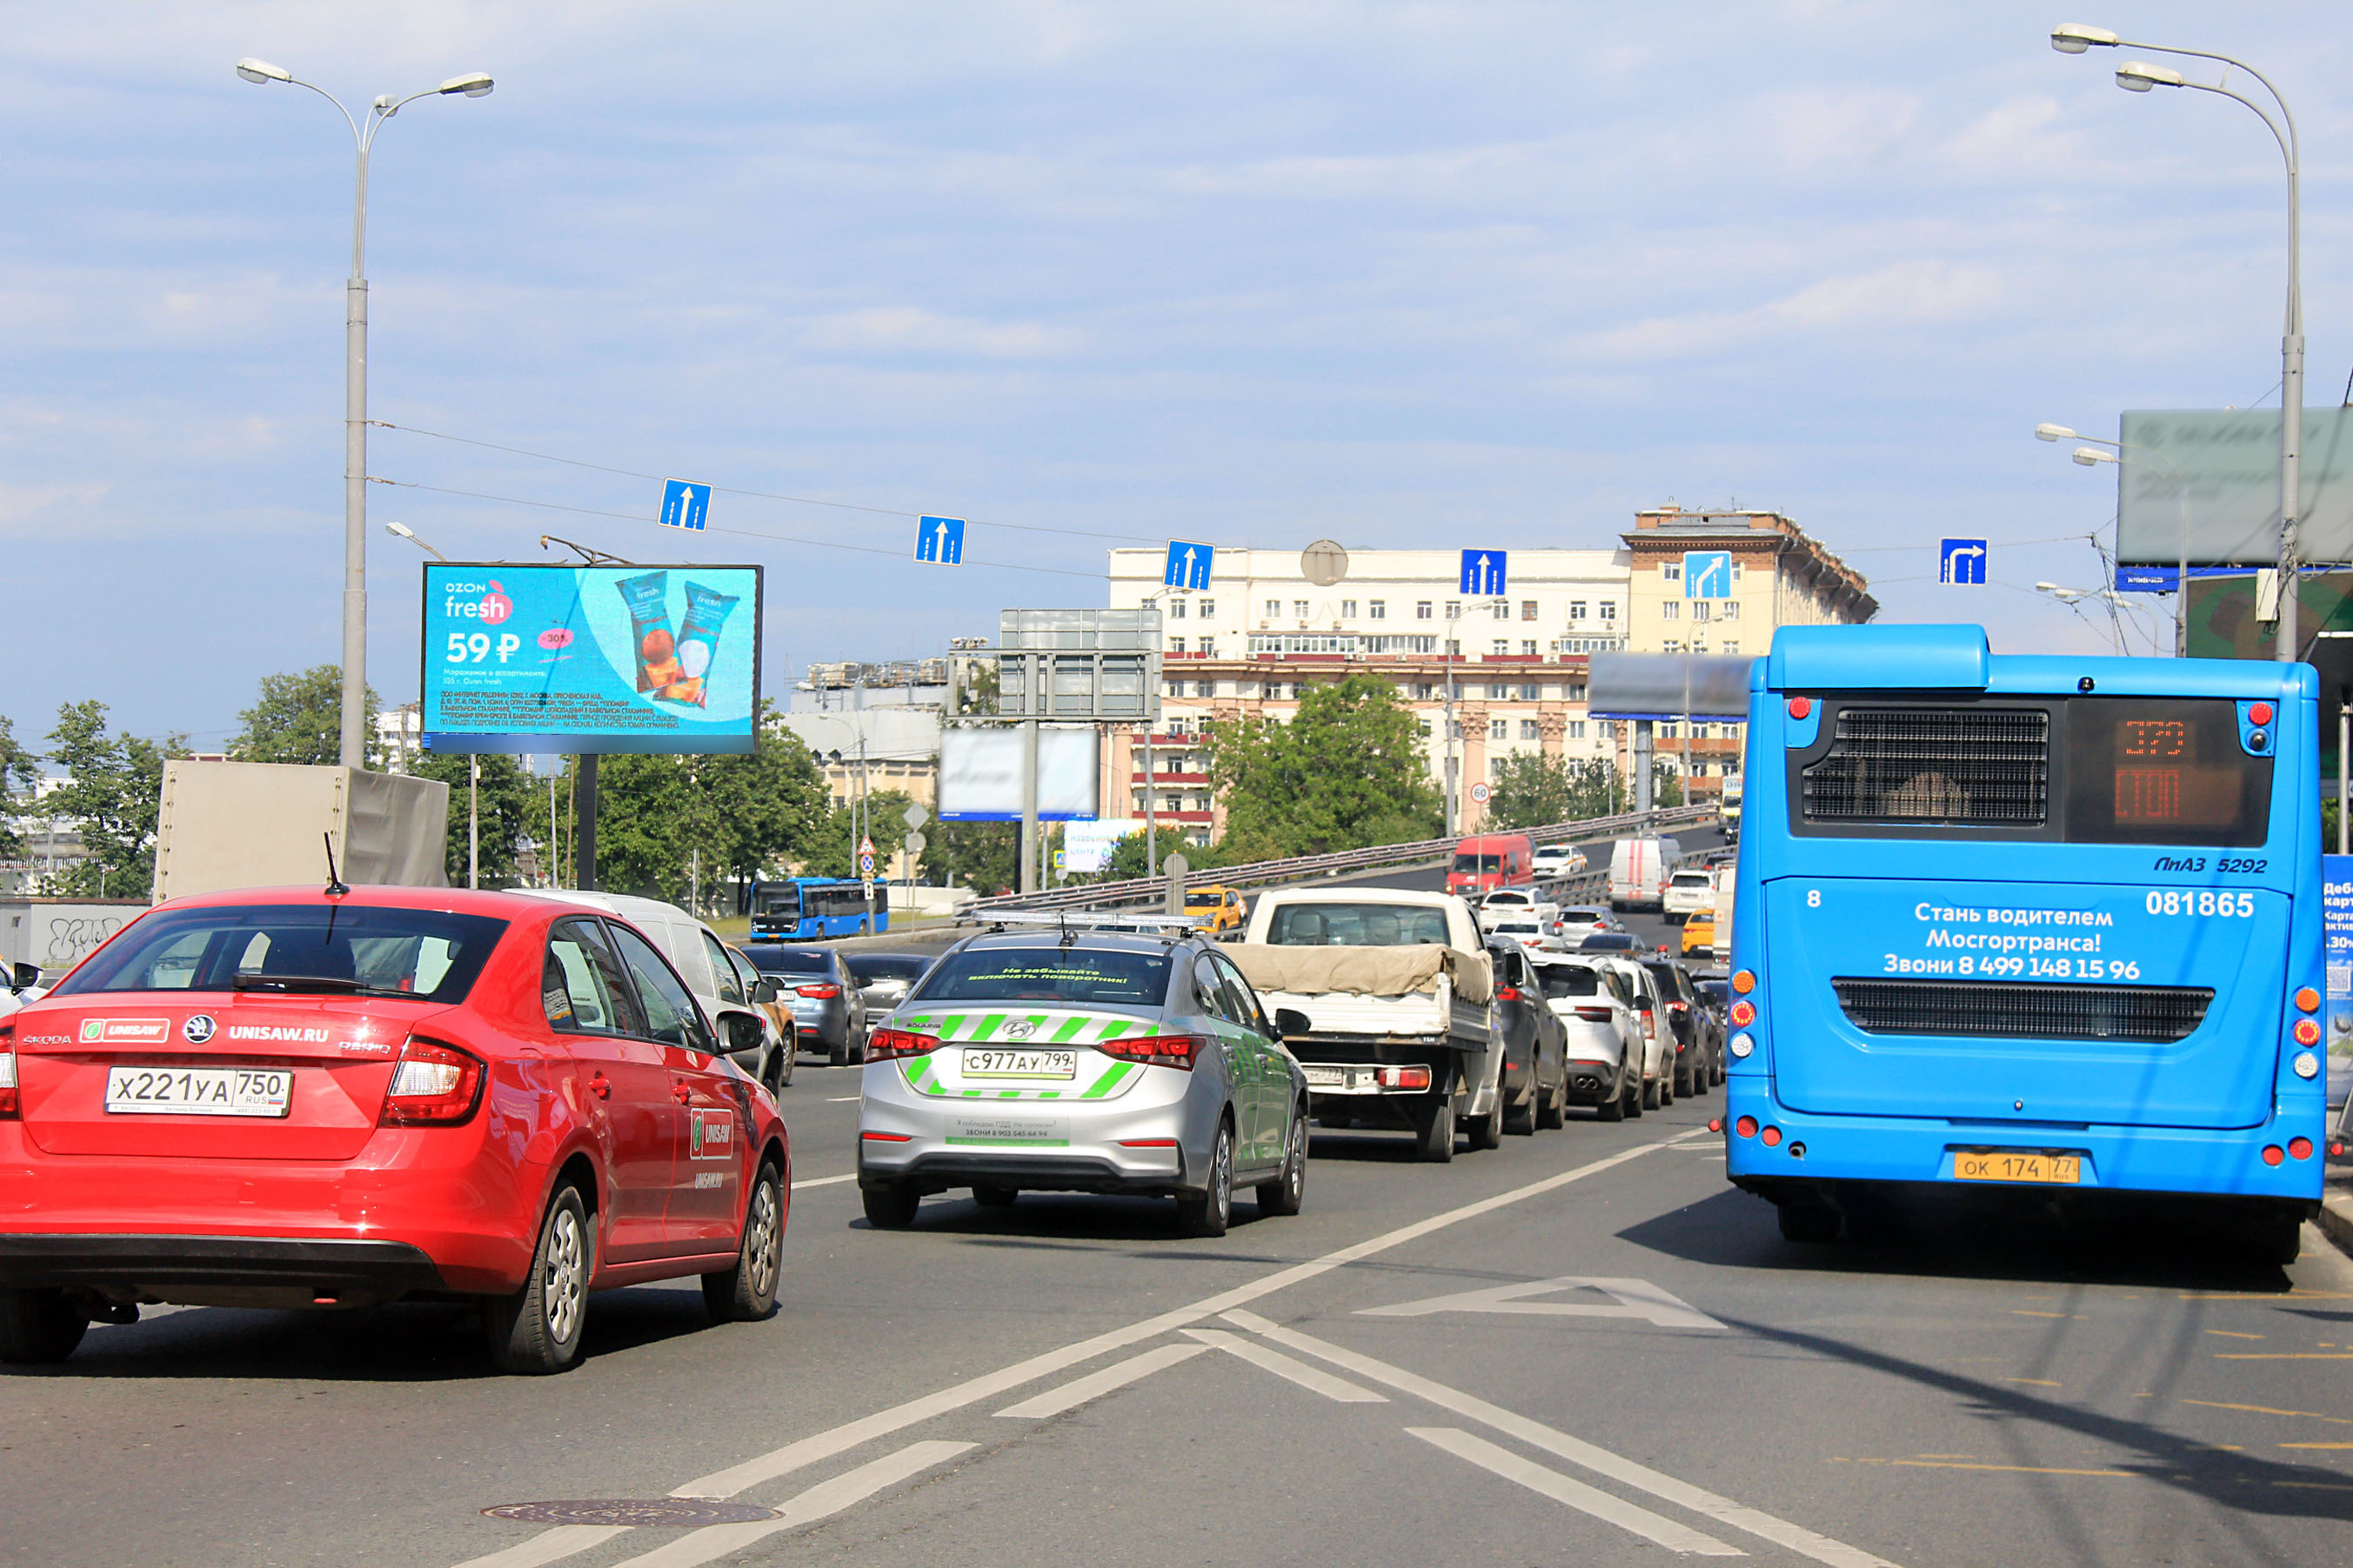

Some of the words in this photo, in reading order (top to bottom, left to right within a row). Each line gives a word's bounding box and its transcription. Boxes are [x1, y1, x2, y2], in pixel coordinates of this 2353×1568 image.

[445, 583, 485, 592] OZON
[445, 595, 505, 617] fresh
[446, 632, 491, 663] 59
[2126, 721, 2183, 756] 379
[1474, 788, 1487, 797] 60
[2115, 770, 2179, 817] СТОП
[2216, 858, 2268, 874] 5292
[1807, 890, 1822, 908] 8
[2323, 882, 2353, 896] Деб
[2145, 891, 2254, 917] 081865
[1915, 903, 1982, 923] Стань
[1987, 908, 2114, 927] водителем
[1925, 928, 2102, 954] Мосгортранса!
[1883, 953, 1954, 973] Звони
[1958, 956, 1974, 975] 8
[1979, 957, 2024, 976] 499
[2029, 957, 2071, 977] 148
[2076, 958, 2104, 978] 15
[2109, 961, 2141, 980] 96
[1040, 974, 1128, 984] поворотник!
[109, 1025, 161, 1036] UNISAW
[229, 1025, 330, 1042] UNISAW.RU
[969, 1052, 1040, 1071] С977АУ
[1044, 1052, 1071, 1066] 799
[117, 1072, 229, 1102] Х221УА
[239, 1073, 282, 1096] 750
[245, 1096, 268, 1104] RUS
[705, 1124, 731, 1144] UNISAW
[1964, 1161, 1989, 1176] ОК
[2002, 1158, 2039, 1178] 174
[2051, 1158, 2072, 1173] 77
